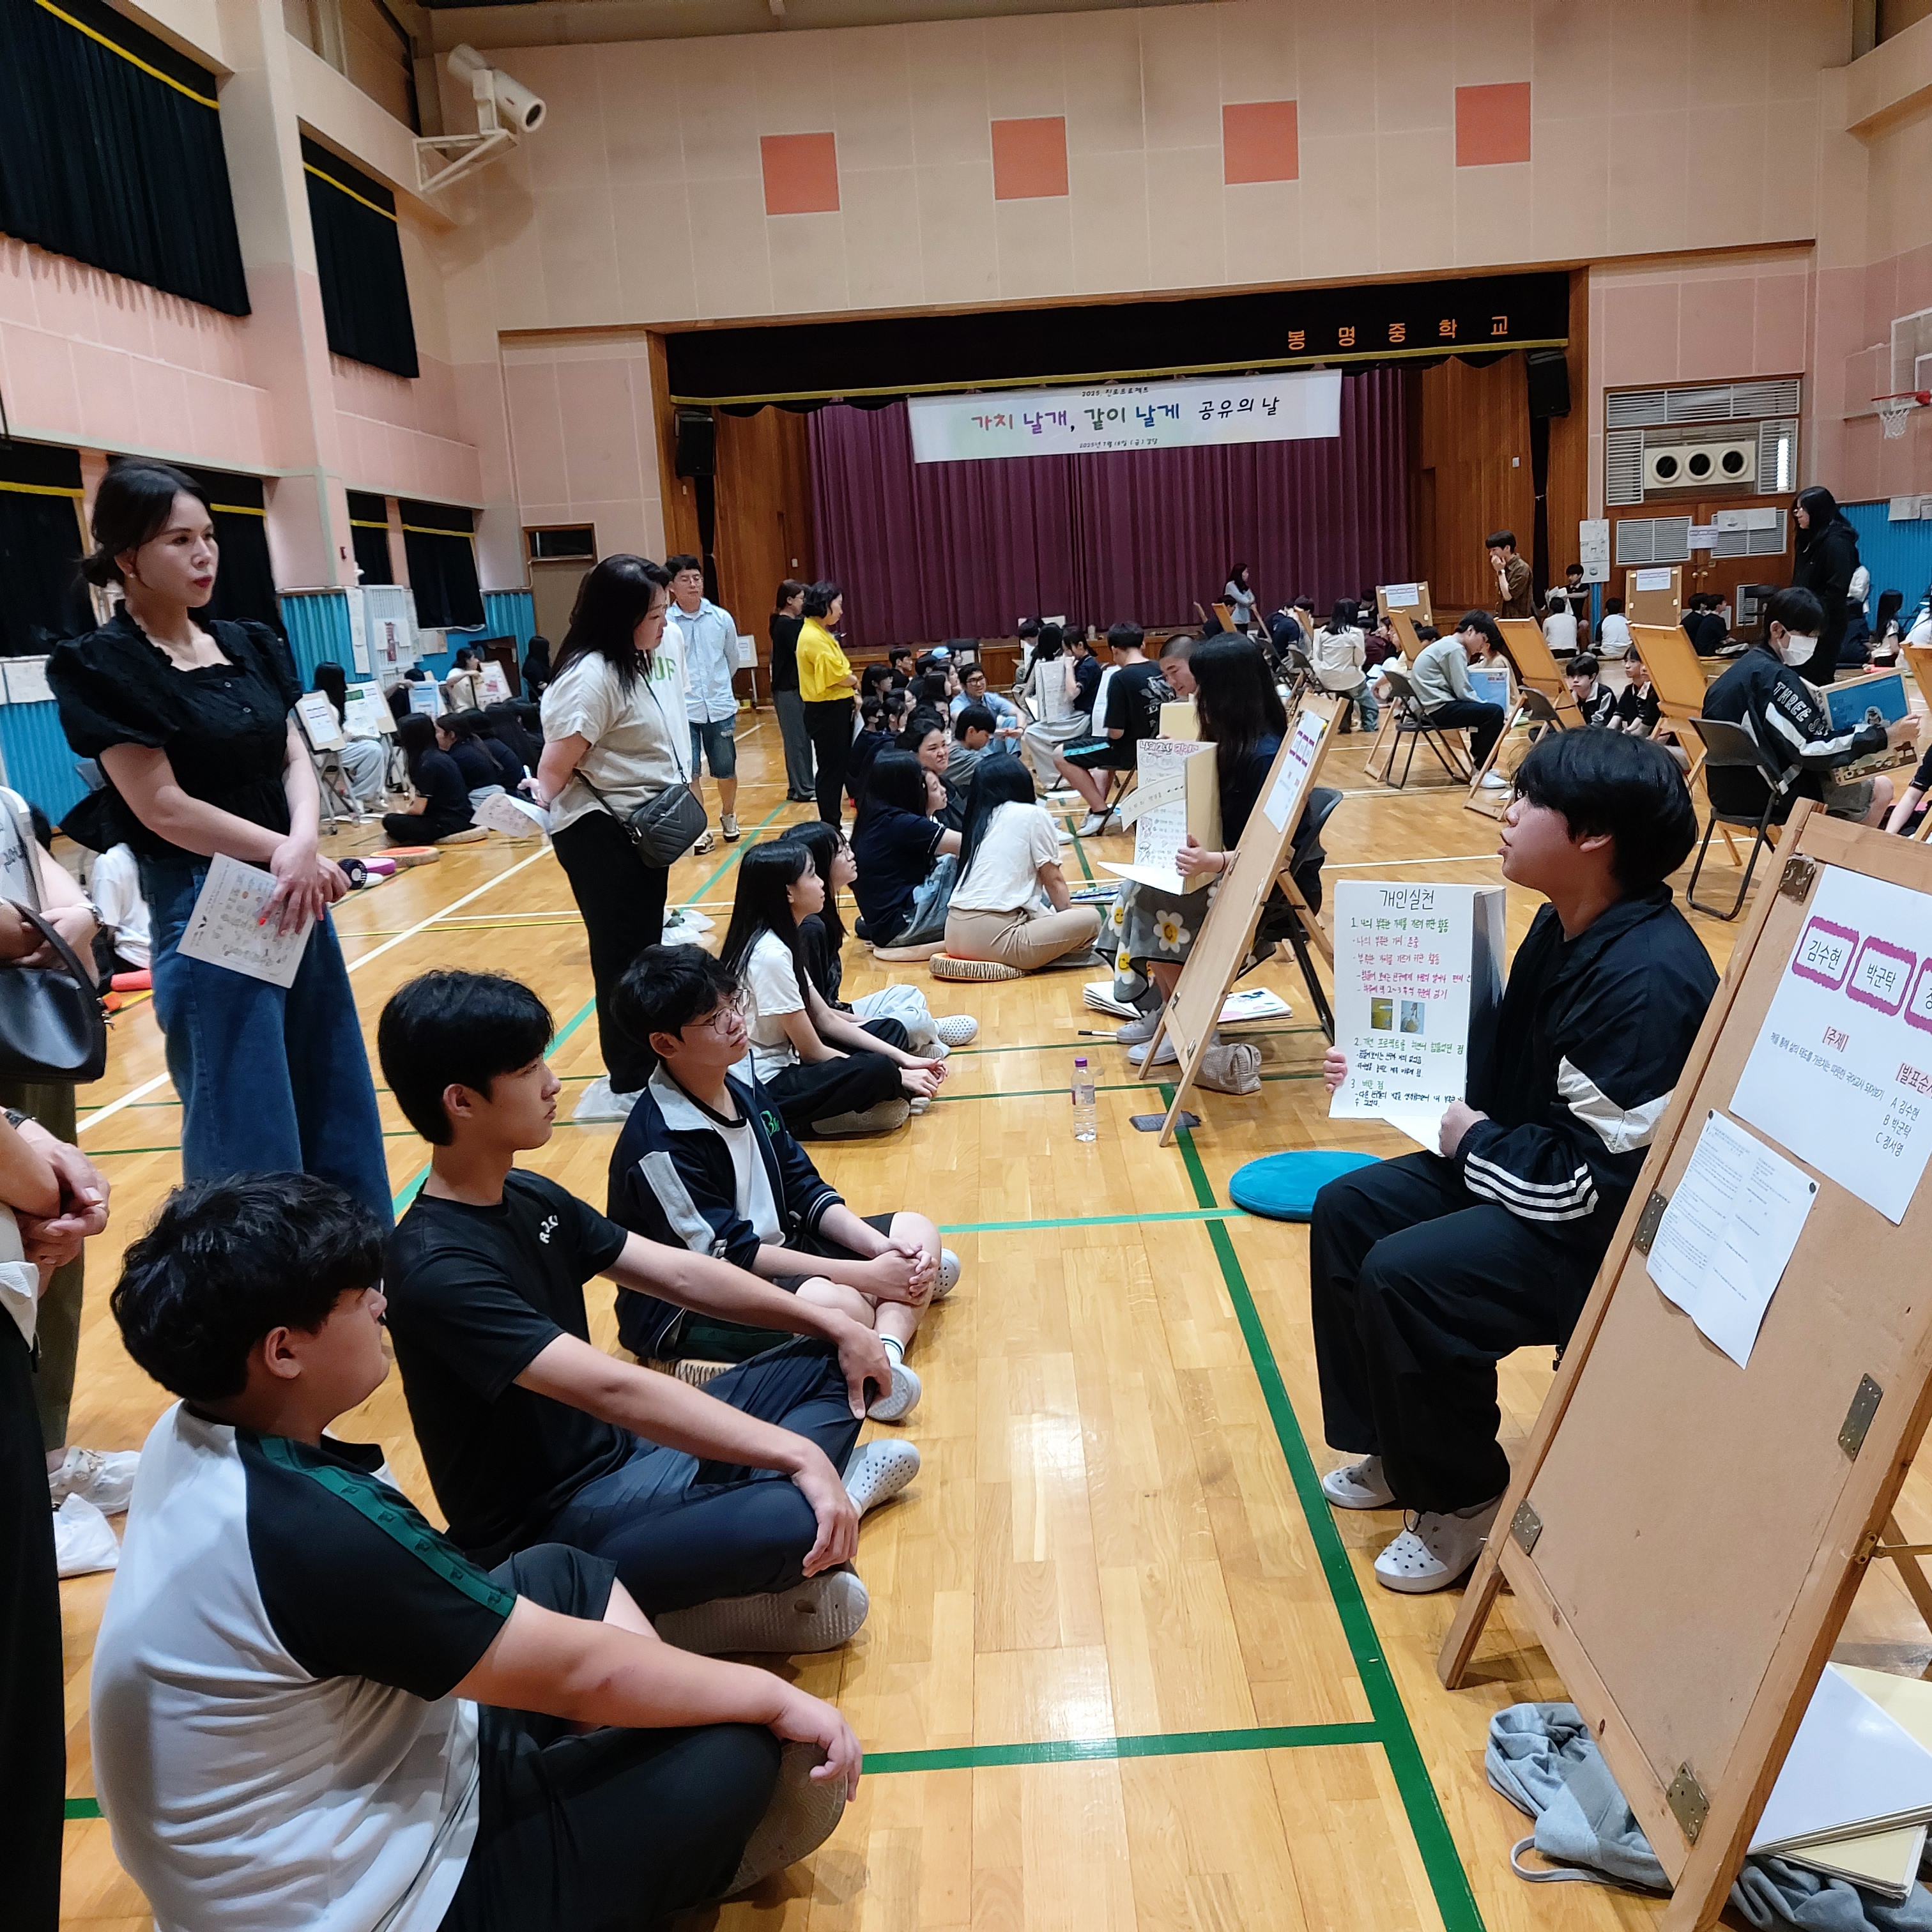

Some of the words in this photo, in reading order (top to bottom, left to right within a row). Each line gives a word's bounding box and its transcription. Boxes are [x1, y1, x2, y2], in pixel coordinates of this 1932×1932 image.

[1287, 316, 1508, 351] 봉명중학교
[1105, 387, 1149, 397] 진로프로젝트
[970, 413, 1013, 431] 가치
[1023, 410, 1075, 434] 날개,
[1084, 407, 1126, 431] 같이
[1135, 402, 1179, 428] 날게
[1199, 398, 1255, 420] 공유의
[1262, 396, 1280, 416] 날
[1773, 681, 1812, 723] THREE
[1379, 888, 1435, 910] 개인실천
[1356, 935, 1371, 947] 나의
[1807, 940, 1843, 971] 김수현
[1866, 963, 1896, 993] 박군탁
[1377, 1038, 1406, 1052] 프로젝트를
[1821, 1026, 1850, 1053] [주제]
[1882, 1114, 1890, 1126] B
[1890, 1097, 1898, 1109] A
[1899, 1100, 1920, 1122] 김수현
[1875, 1131, 1883, 1144] C
[1882, 1135, 1905, 1157] 정서영
